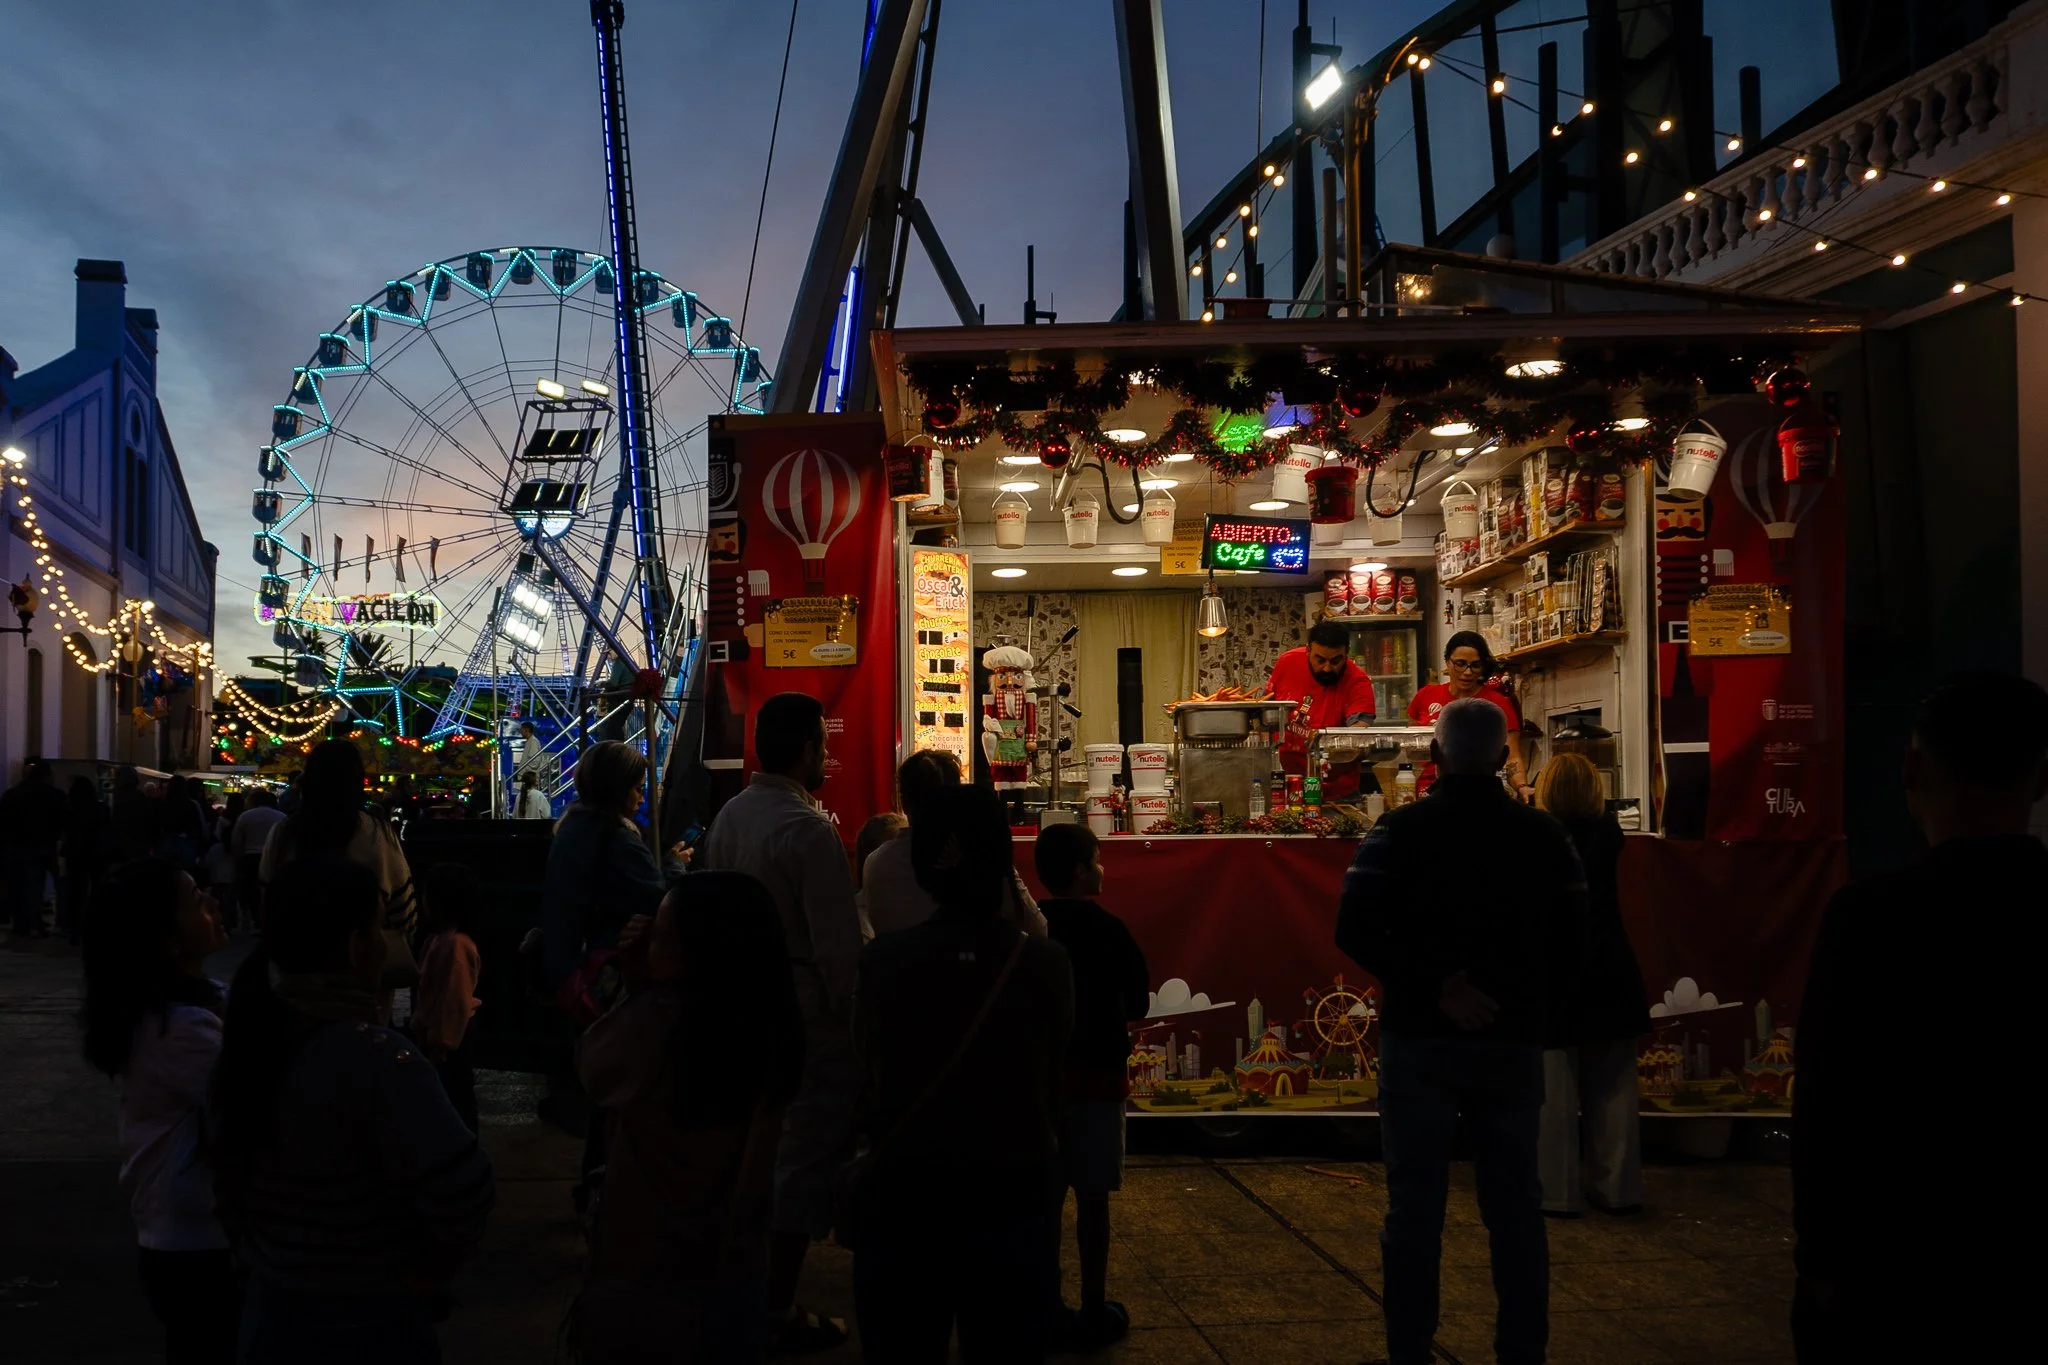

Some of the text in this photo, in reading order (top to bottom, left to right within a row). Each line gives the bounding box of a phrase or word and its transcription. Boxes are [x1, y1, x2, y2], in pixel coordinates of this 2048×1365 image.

[1686, 447, 1719, 461] nutella
[1070, 511, 1093, 519] nutella
[1146, 510, 1170, 518] nutella
[1216, 543, 1265, 565] Cafe
[917, 574, 965, 598] Óscar &
[935, 595, 966, 608] Erick
[918, 615, 953, 628] Churros
[783, 649, 797, 659] 5€
[919, 646, 961, 660] Chocolate
[915, 701, 963, 712] Bebidas Agua
[1139, 754, 1165, 763] nutella
[1141, 801, 1166, 809] nutella
